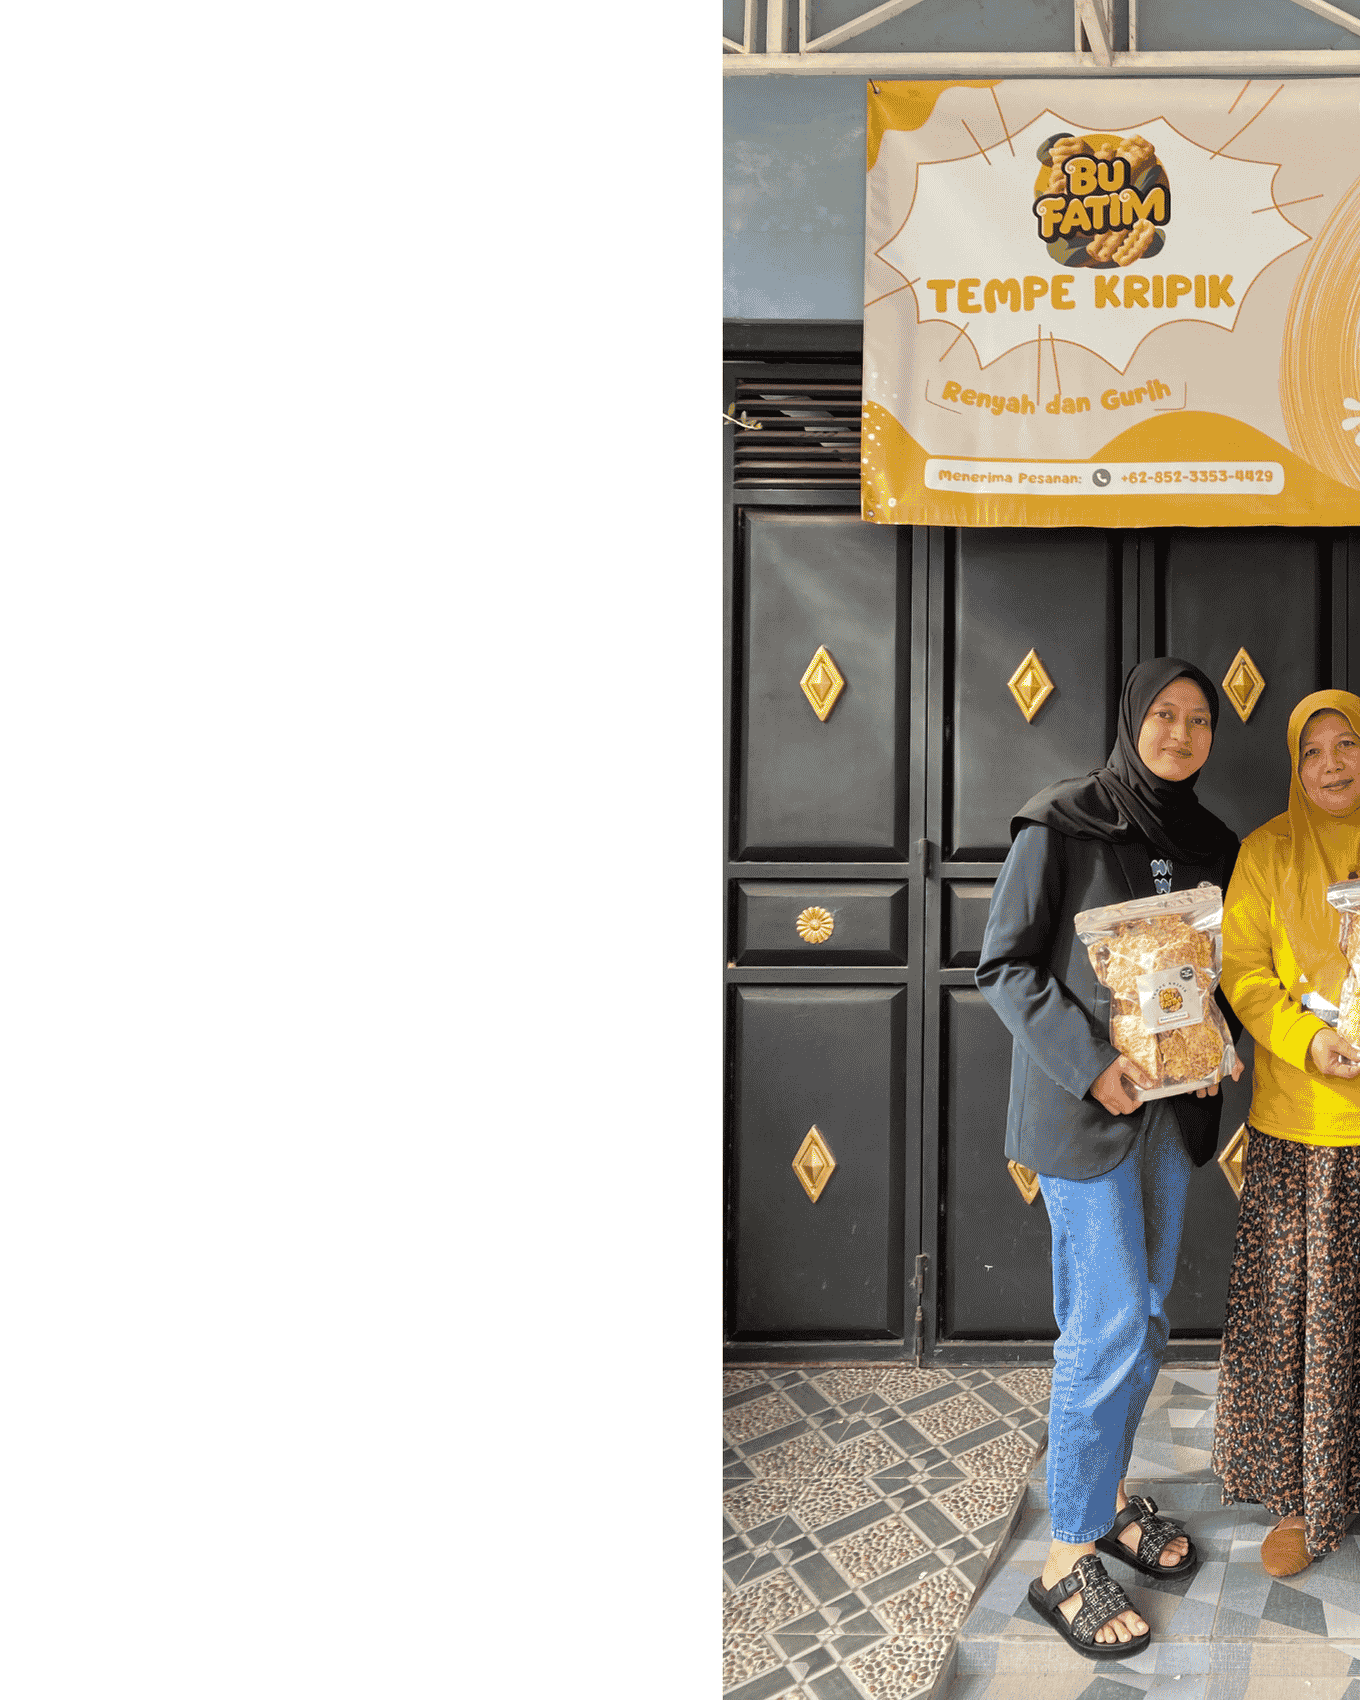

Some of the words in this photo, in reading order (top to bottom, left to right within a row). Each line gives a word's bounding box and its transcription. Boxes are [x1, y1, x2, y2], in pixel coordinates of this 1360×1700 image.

[1064, 156, 1126, 196] BU
[1036, 186, 1166, 237] FATIM
[926, 274, 1077, 313] TEMPE
[1094, 273, 1236, 309] KRIPIK
[941, 380, 1036, 416] Renyah
[1045, 393, 1091, 415] dan
[1100, 378, 1172, 411] Gurih
[938, 469, 1013, 484] Menerima
[1018, 472, 1082, 485] Pesanan:
[1121, 469, 1274, 483] +62-852-3353-4429
